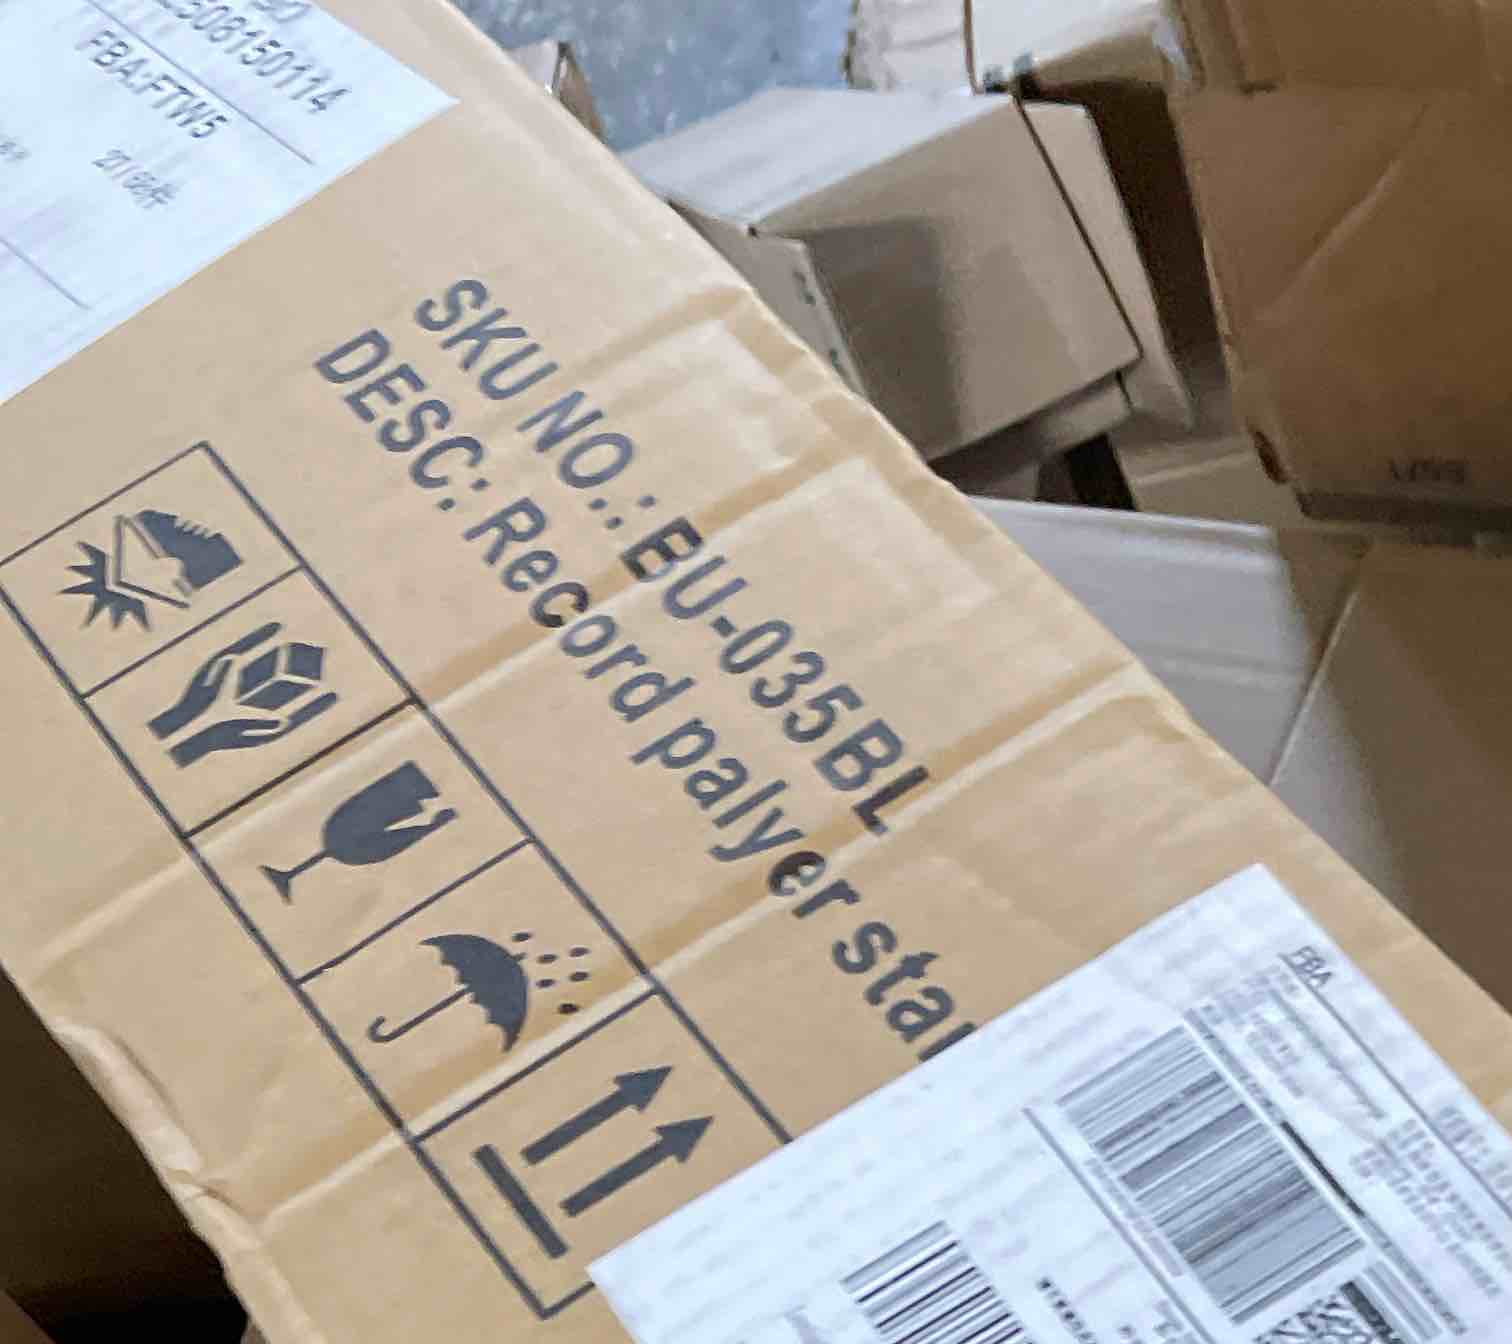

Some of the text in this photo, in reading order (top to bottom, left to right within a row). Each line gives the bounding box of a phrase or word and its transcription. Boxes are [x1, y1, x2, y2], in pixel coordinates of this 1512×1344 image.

[415, 279, 560, 401] SKU
[313, 328, 491, 512] DESC:
[463, 495, 695, 723] Record
[628, 717, 861, 919] palyer
